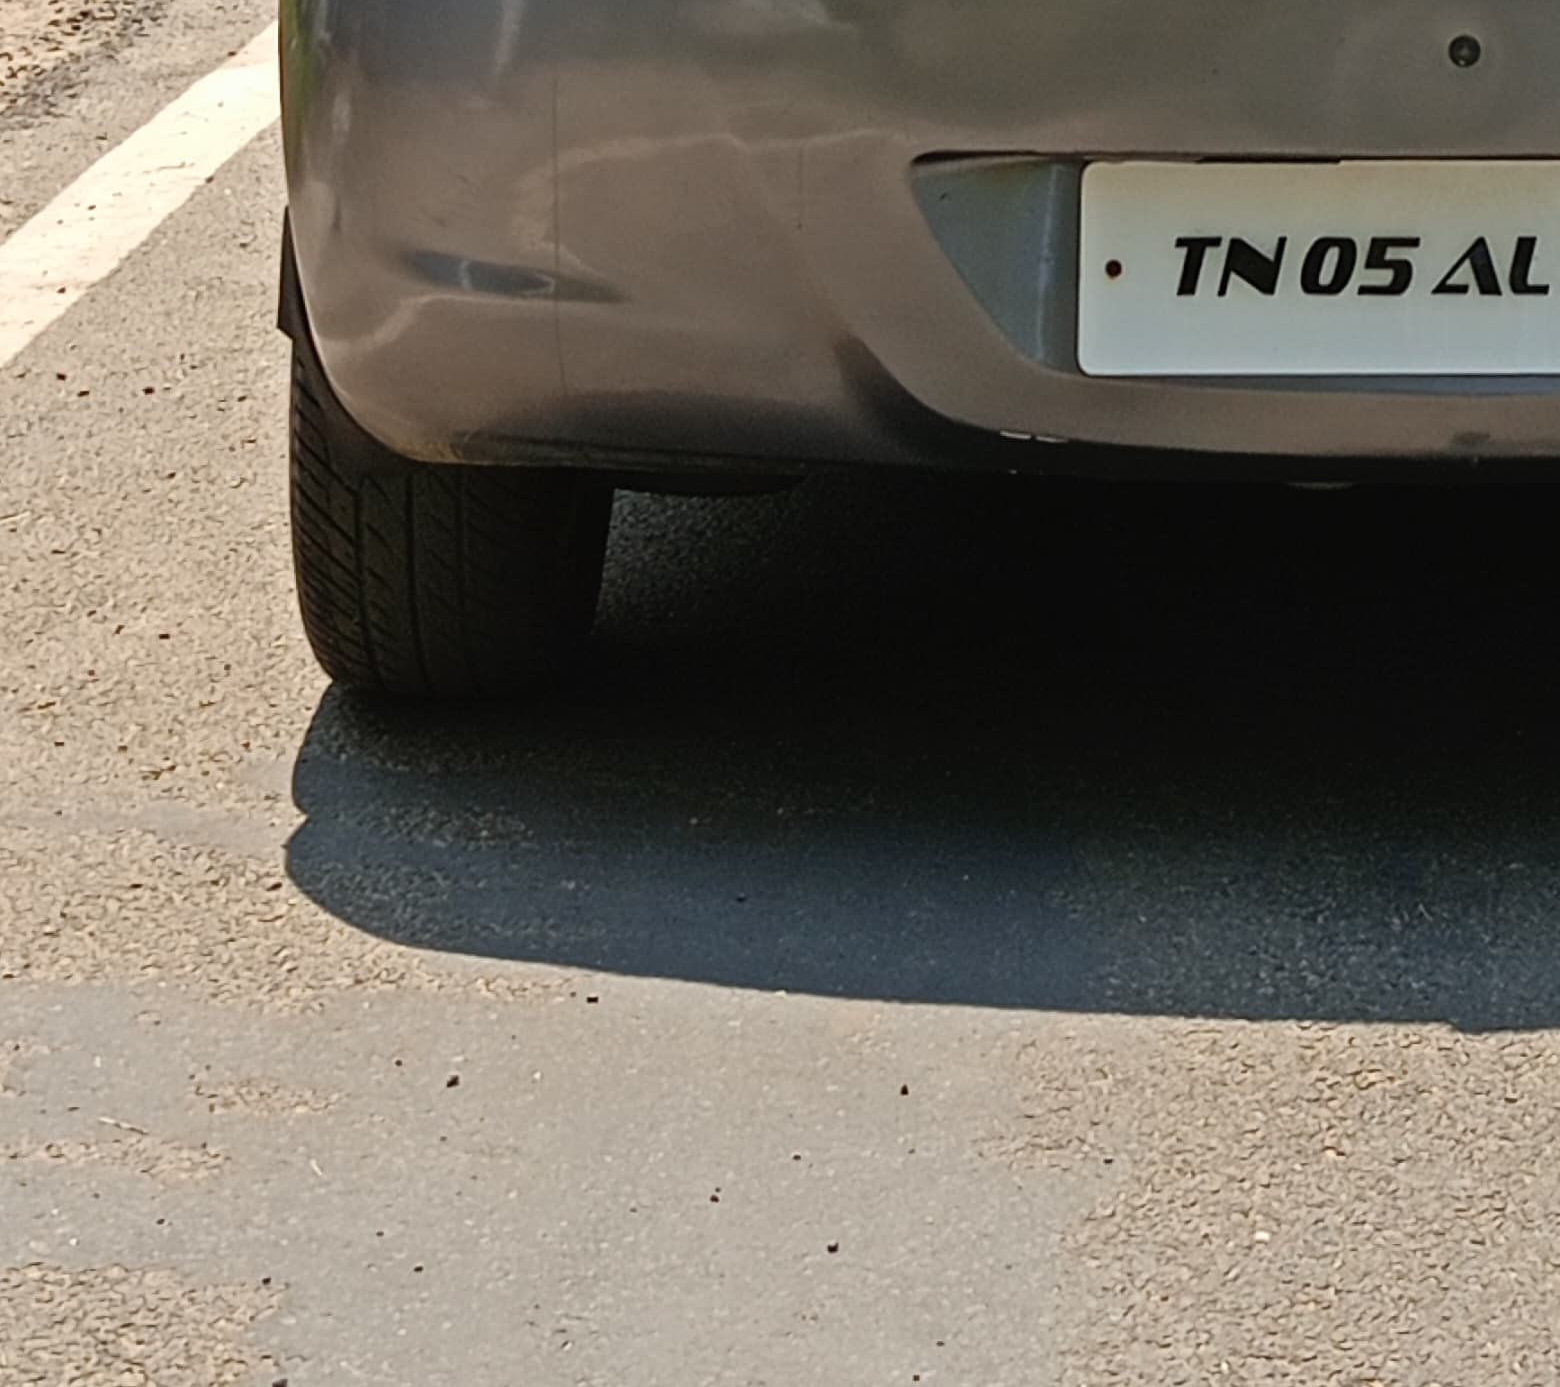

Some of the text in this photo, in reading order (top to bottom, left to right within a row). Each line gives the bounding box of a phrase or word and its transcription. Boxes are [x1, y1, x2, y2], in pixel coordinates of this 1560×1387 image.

[1174, 237, 1287, 297] TN
[1300, 237, 1421, 296] 05
[1431, 236, 1550, 296] AL
